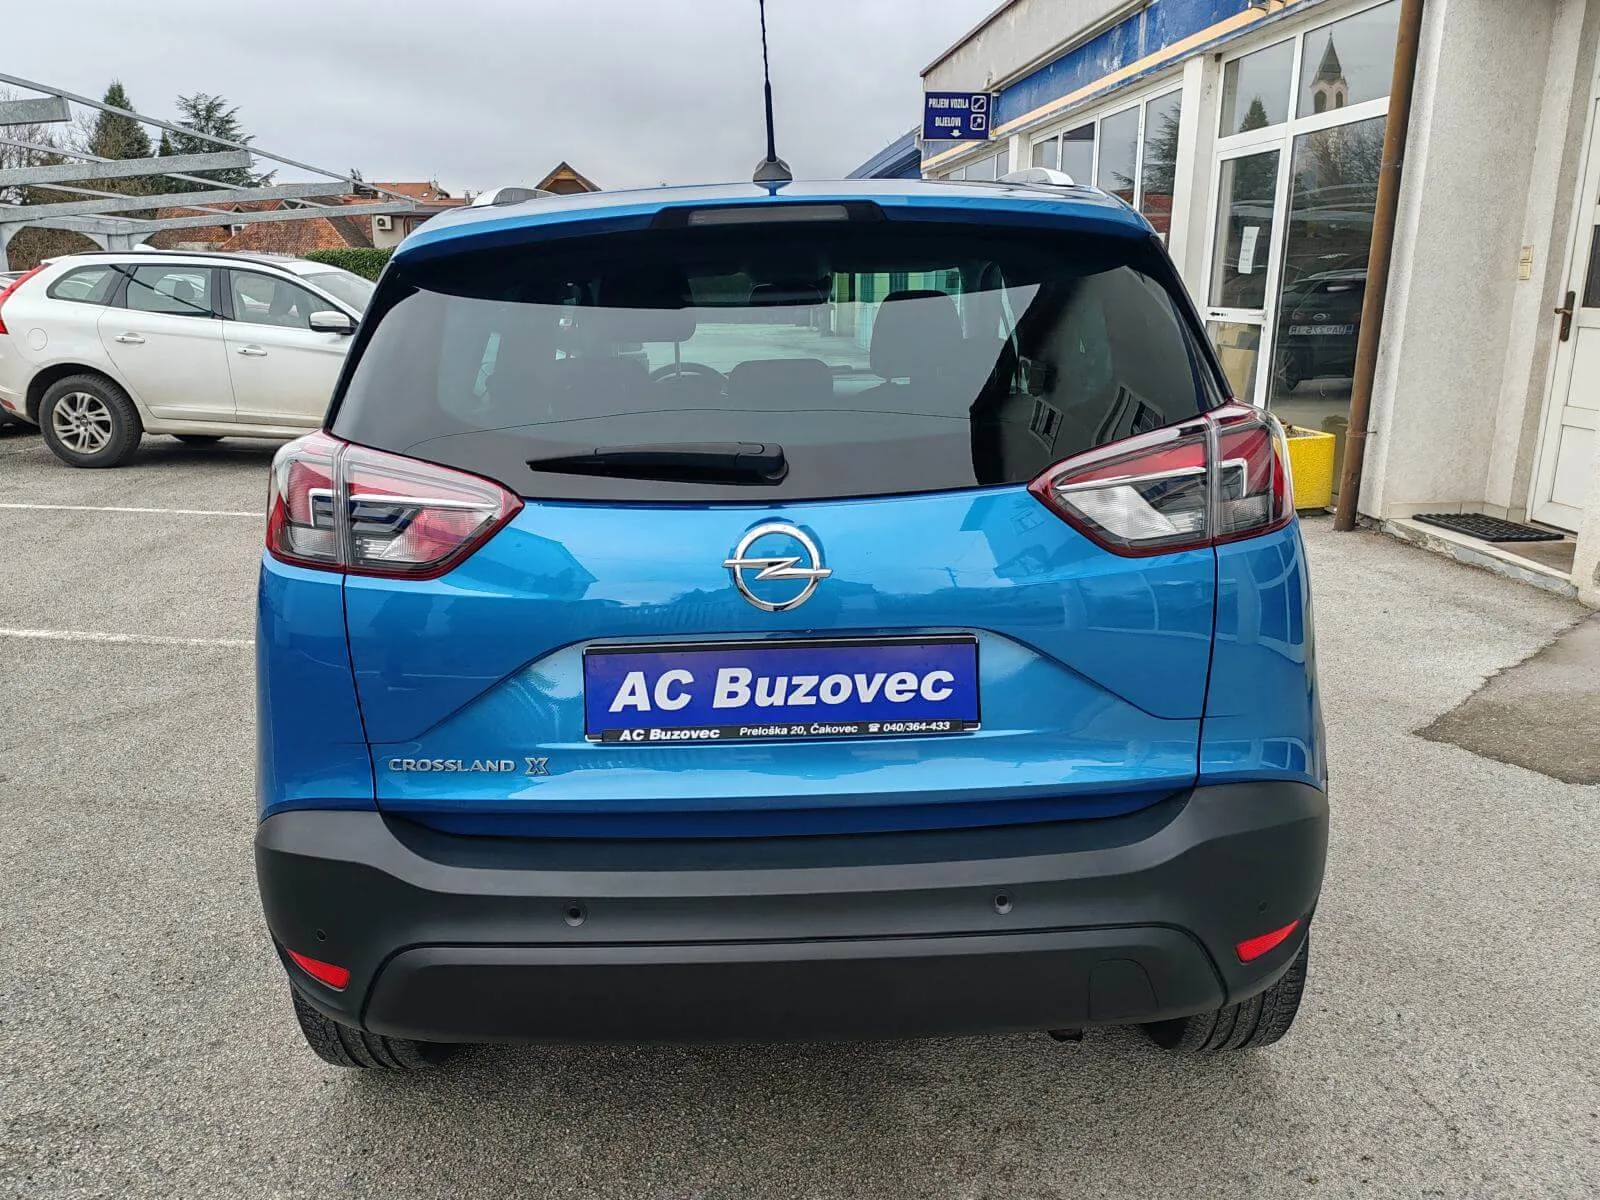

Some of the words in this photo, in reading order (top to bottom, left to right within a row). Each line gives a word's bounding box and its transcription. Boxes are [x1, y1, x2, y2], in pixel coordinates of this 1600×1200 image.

[928, 98, 949, 108] PRIJEM
[950, 98, 969, 109] VOZILA
[935, 116, 961, 127] DIJELOVI
[608, 669, 693, 713] AC
[712, 667, 954, 709] Buzovec
[619, 729, 645, 741] AC
[649, 728, 720, 740] Buzovec
[739, 725, 788, 736] Preloška
[790, 725, 807, 736] 20,
[810, 723, 858, 734] Čakovec
[883, 721, 950, 732] 040/364-433
[388, 758, 516, 772] CROSSLAND
[524, 757, 550, 775] X
